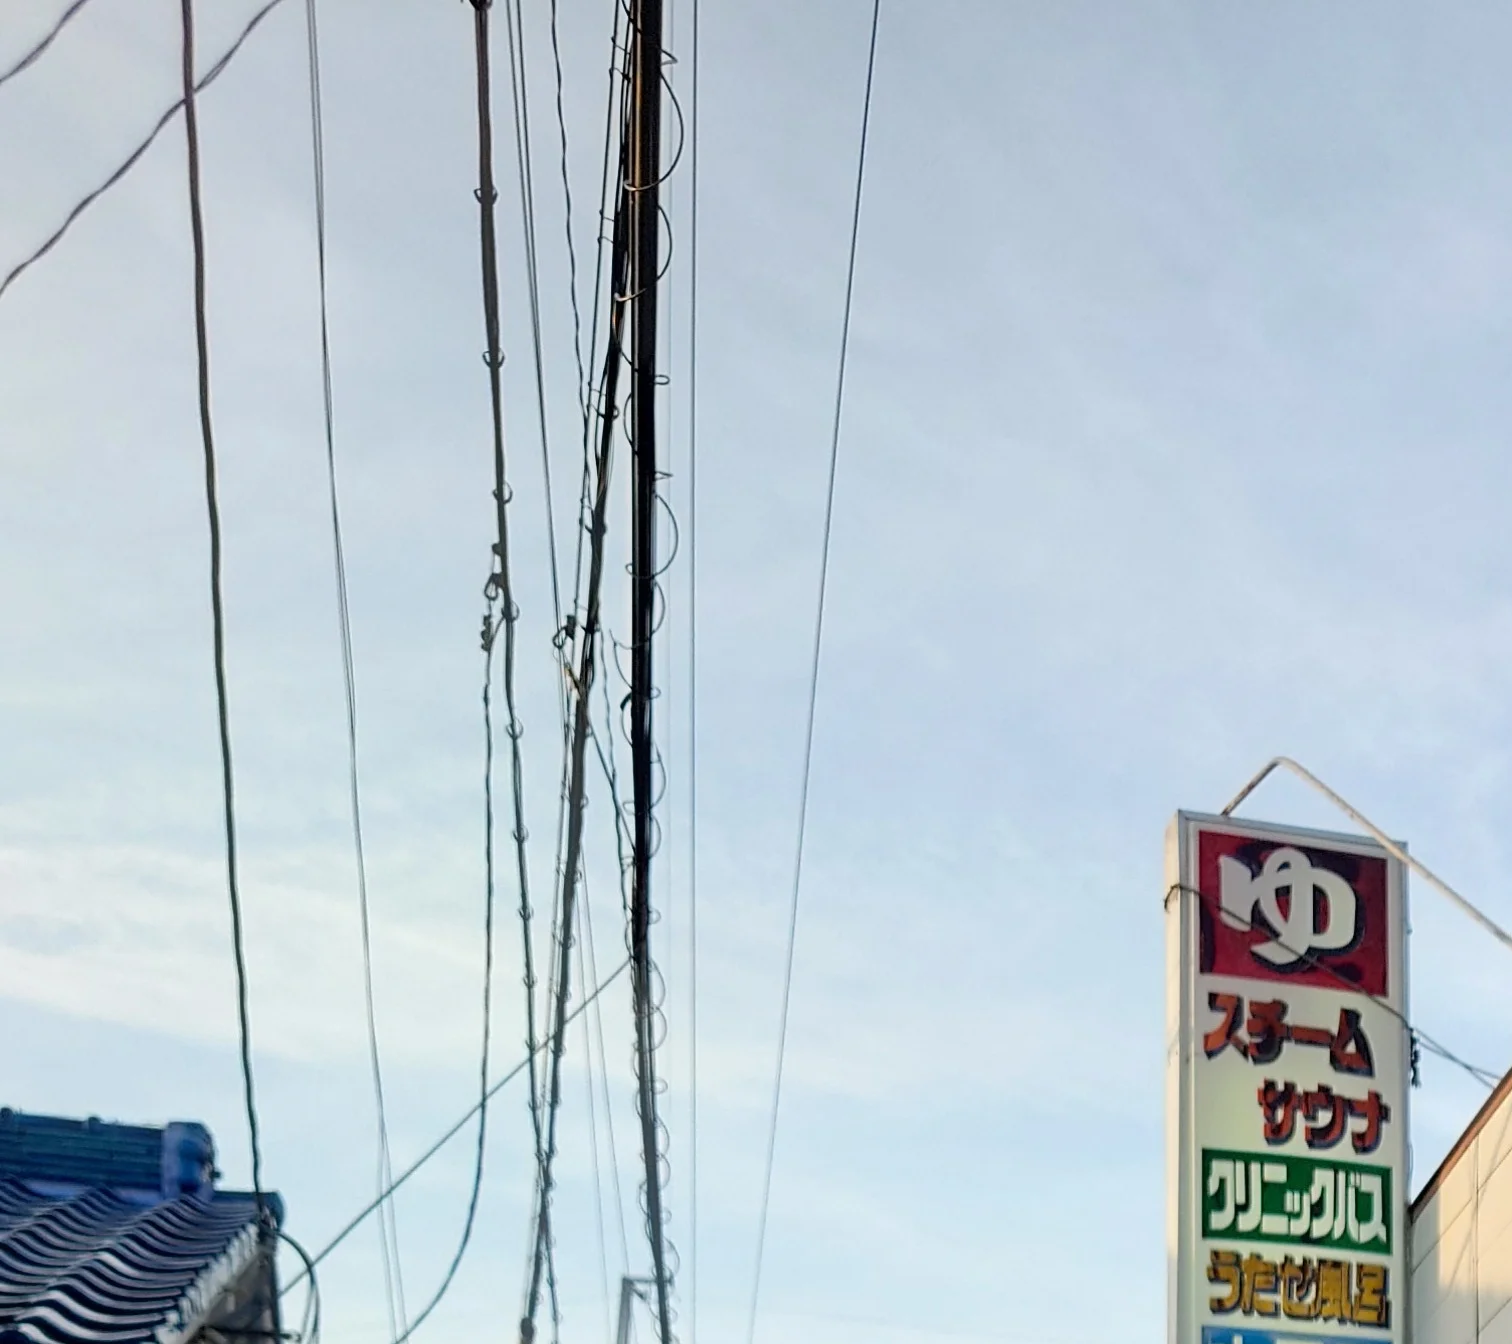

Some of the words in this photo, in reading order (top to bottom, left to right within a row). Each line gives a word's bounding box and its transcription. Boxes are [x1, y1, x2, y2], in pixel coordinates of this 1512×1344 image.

[1219, 846, 1357, 964] ゆ
[1203, 992, 1375, 1078] スチーム
[1258, 1078, 1391, 1154] サウナ
[1208, 1158, 1387, 1243] クリニックバス
